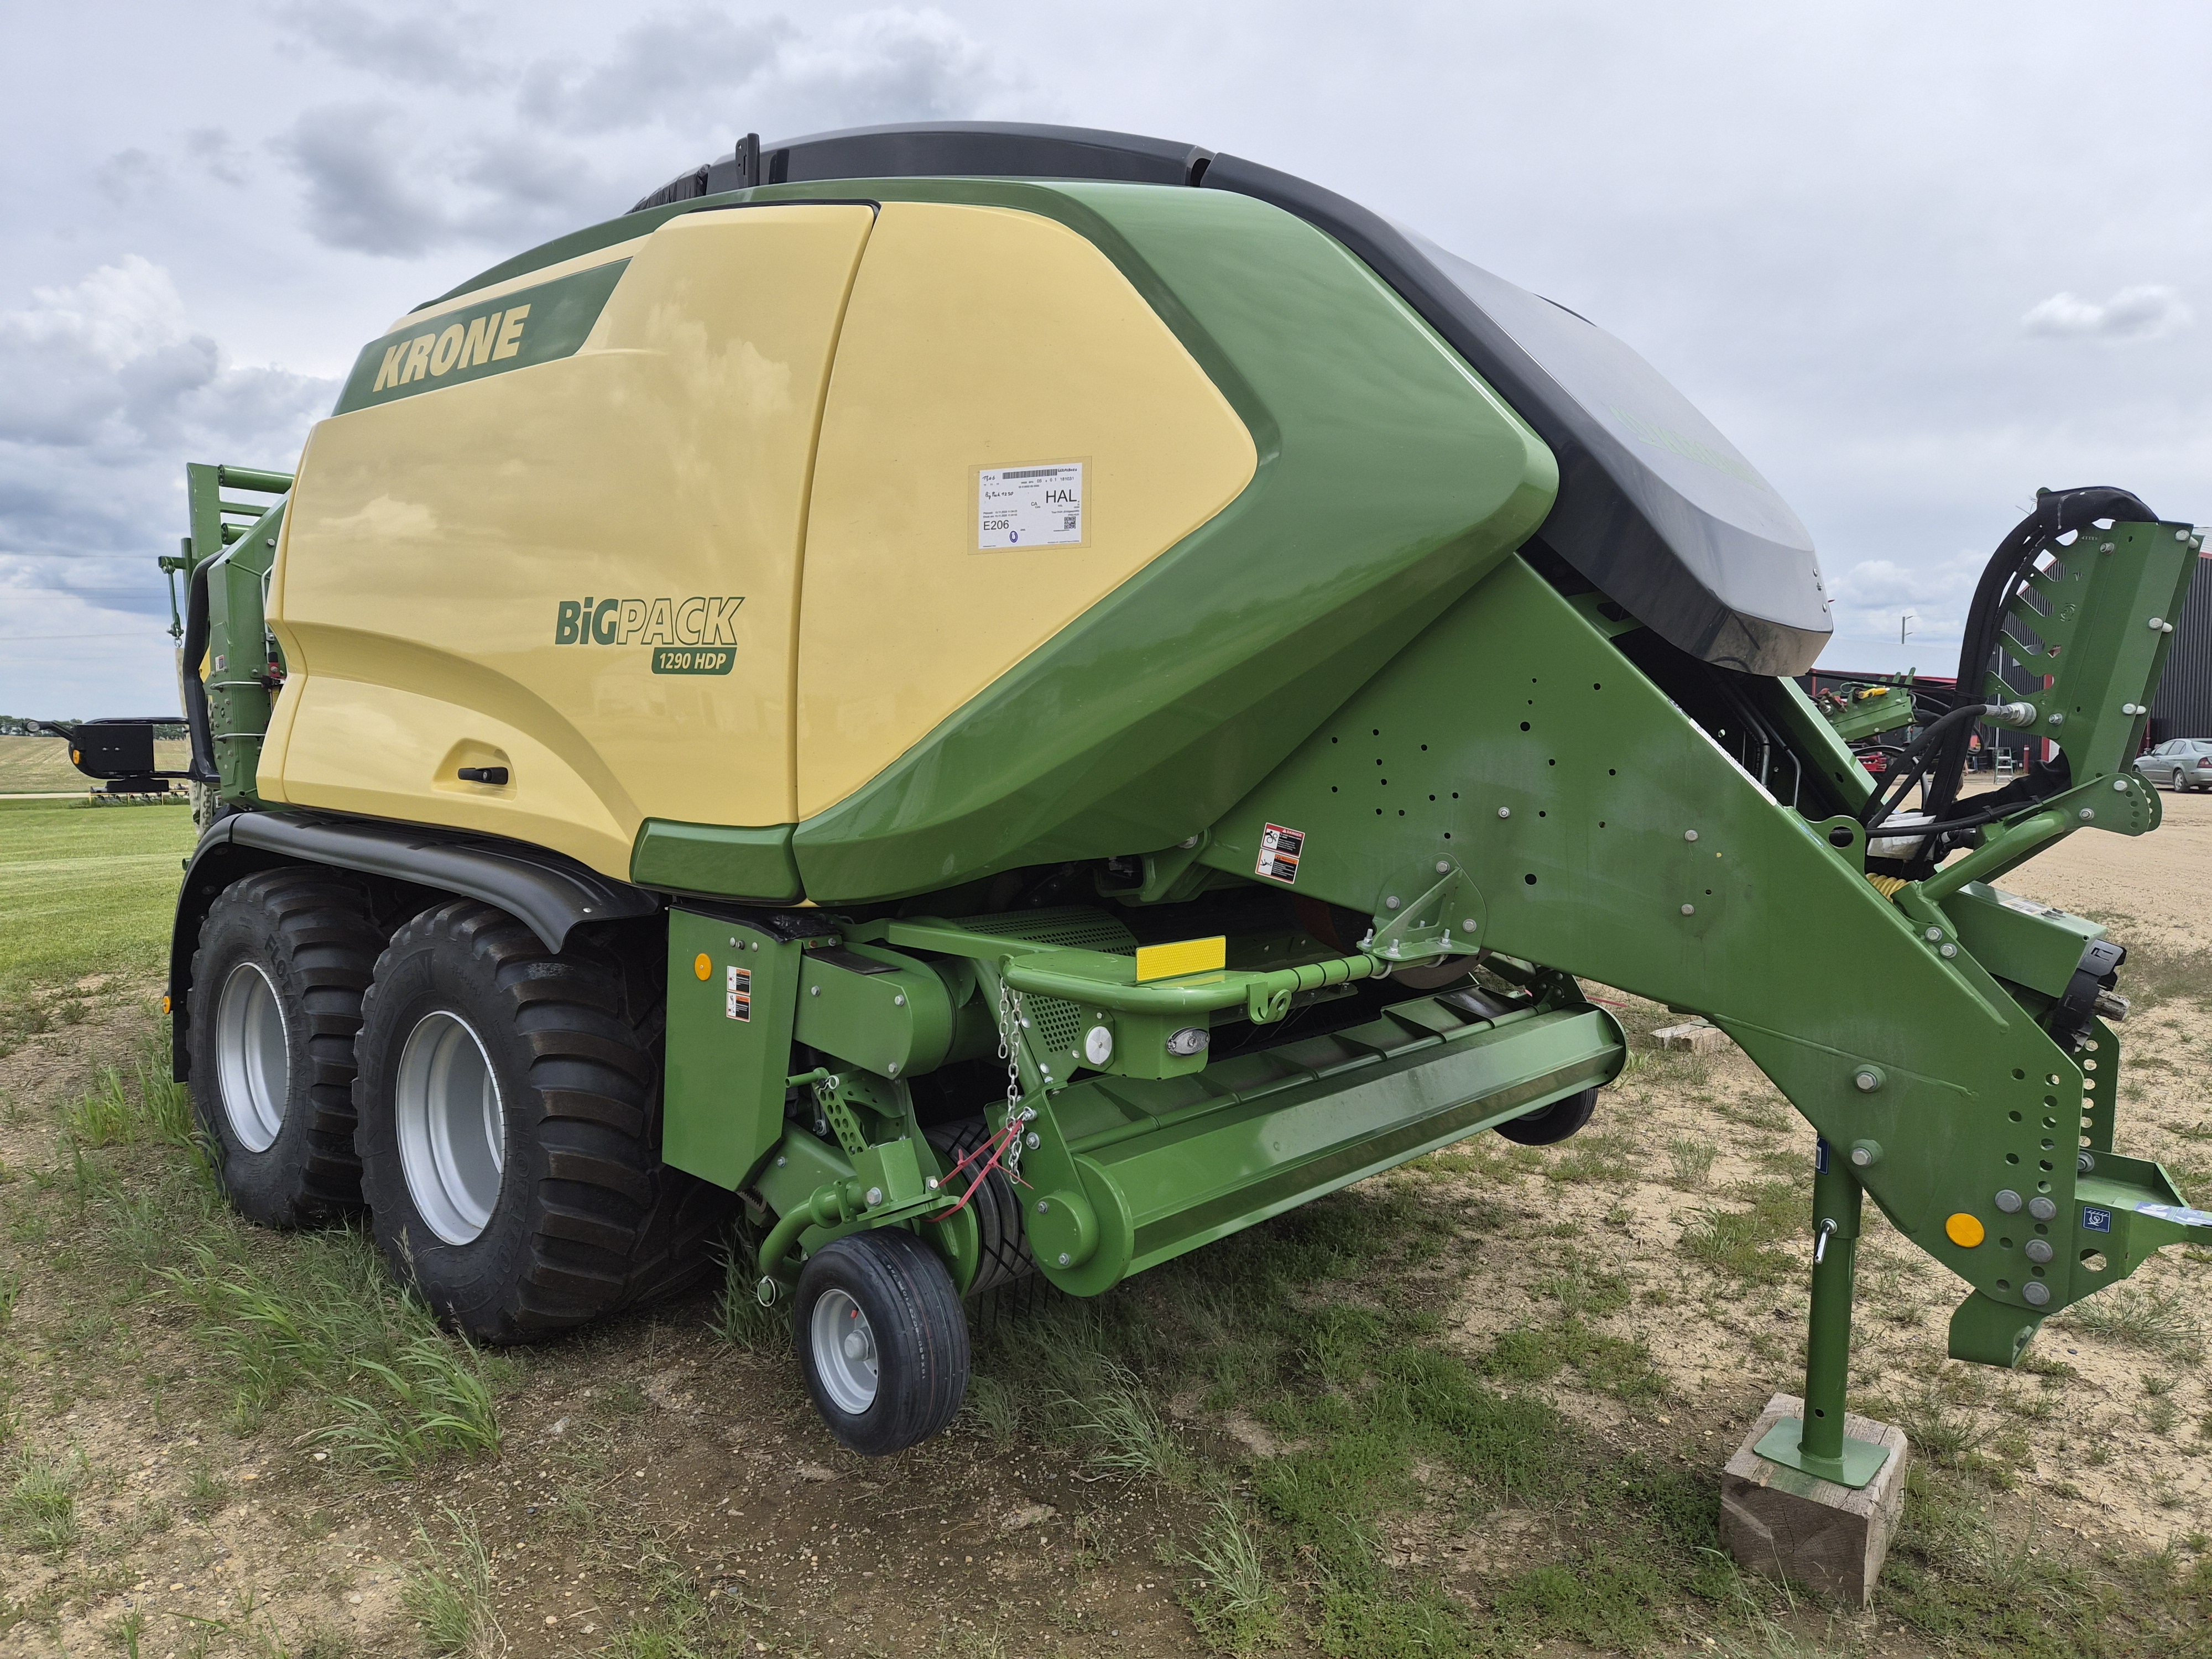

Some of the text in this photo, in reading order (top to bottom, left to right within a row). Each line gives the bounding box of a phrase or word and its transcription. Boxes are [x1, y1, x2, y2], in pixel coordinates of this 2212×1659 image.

[373, 304, 531, 392] KRONE
[1046, 489, 1077, 503] HAL
[984, 519, 1009, 531] E206
[660, 653, 726, 669] 1290 HDP
[264, 931, 307, 1092] FLOTATION
